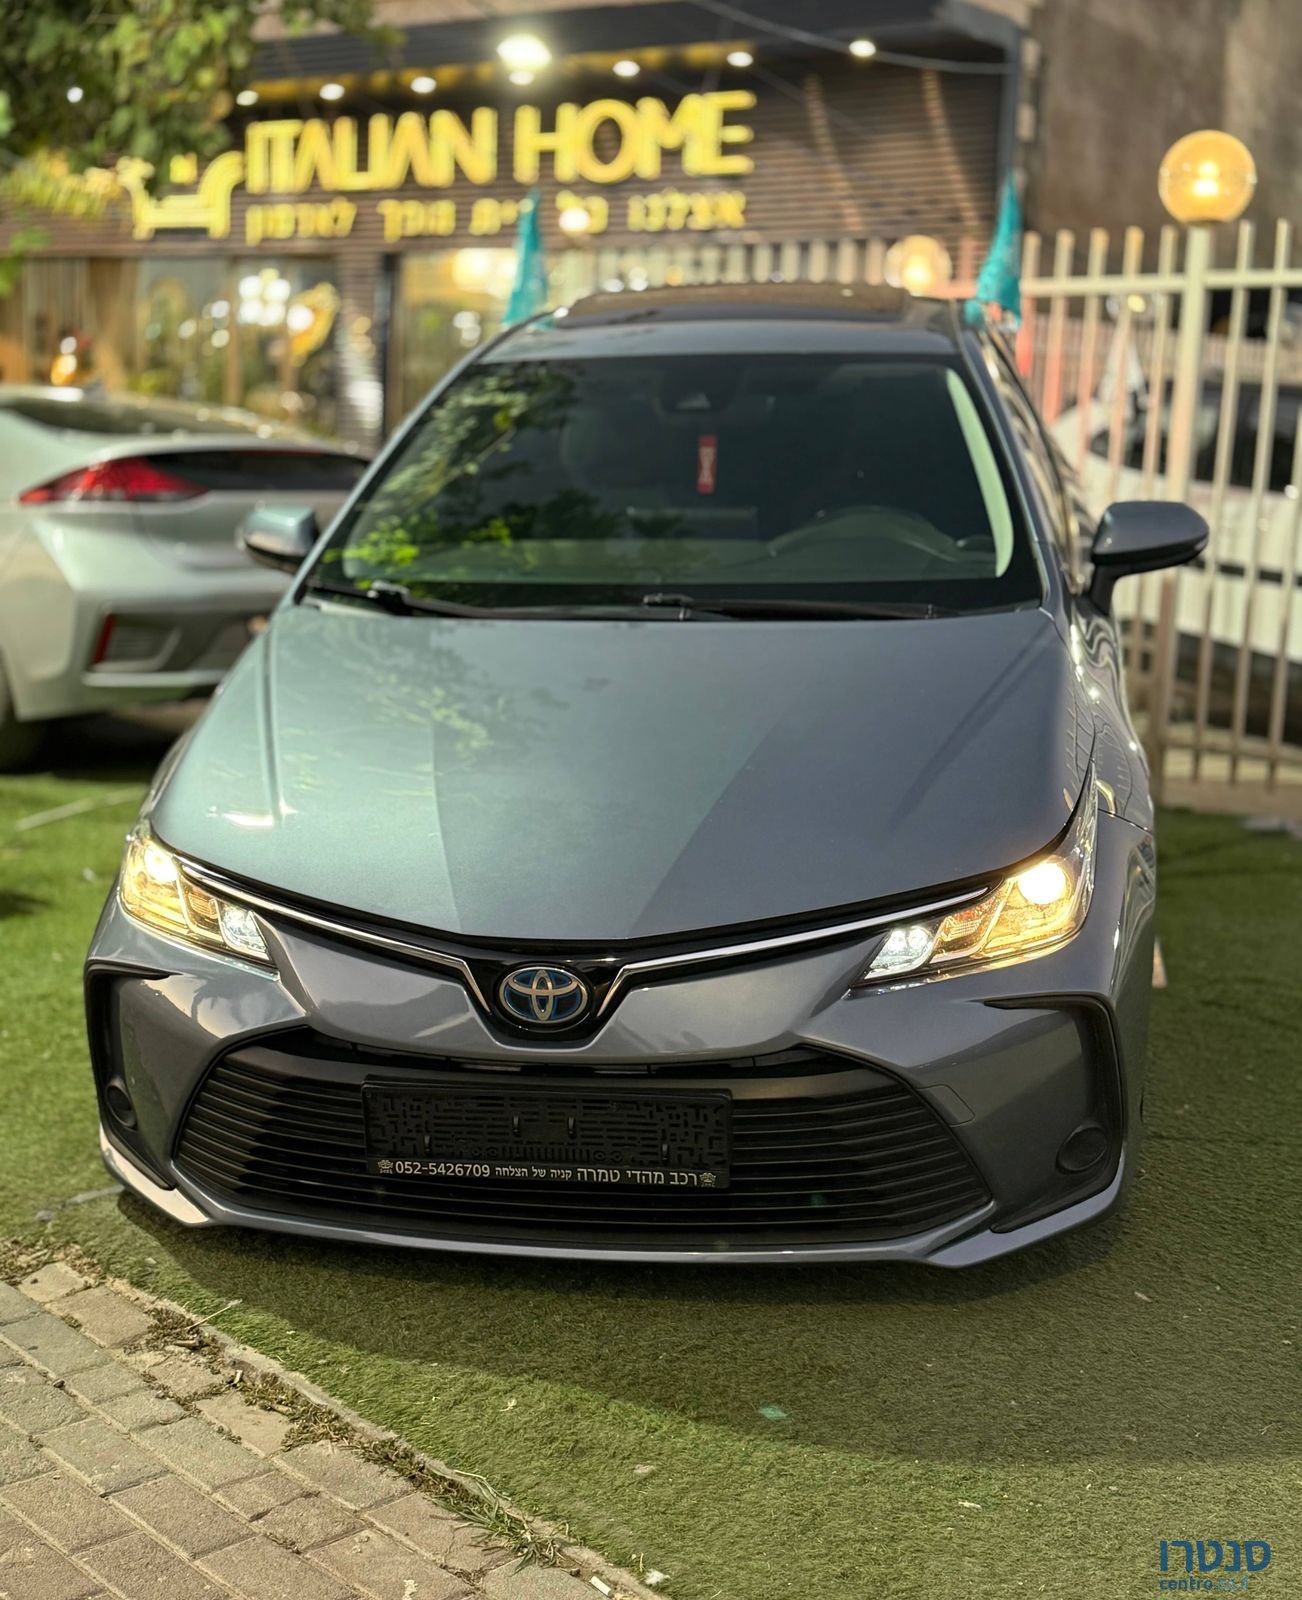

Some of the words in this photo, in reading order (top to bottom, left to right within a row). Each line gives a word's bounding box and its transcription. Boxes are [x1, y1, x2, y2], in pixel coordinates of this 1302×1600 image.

[246, 106, 498, 194] ITALIAN
[514, 90, 756, 184] HOME
[395, 1160, 490, 1178] 052-5426709
[495, 1165, 528, 1178] הצלחה
[532, 1165, 546, 1178] של
[550, 1168, 572, 1181] קניה
[577, 1167, 621, 1183] טמרה
[626, 1169, 665, 1185] מהדי
[670, 1171, 698, 1186] רכב
